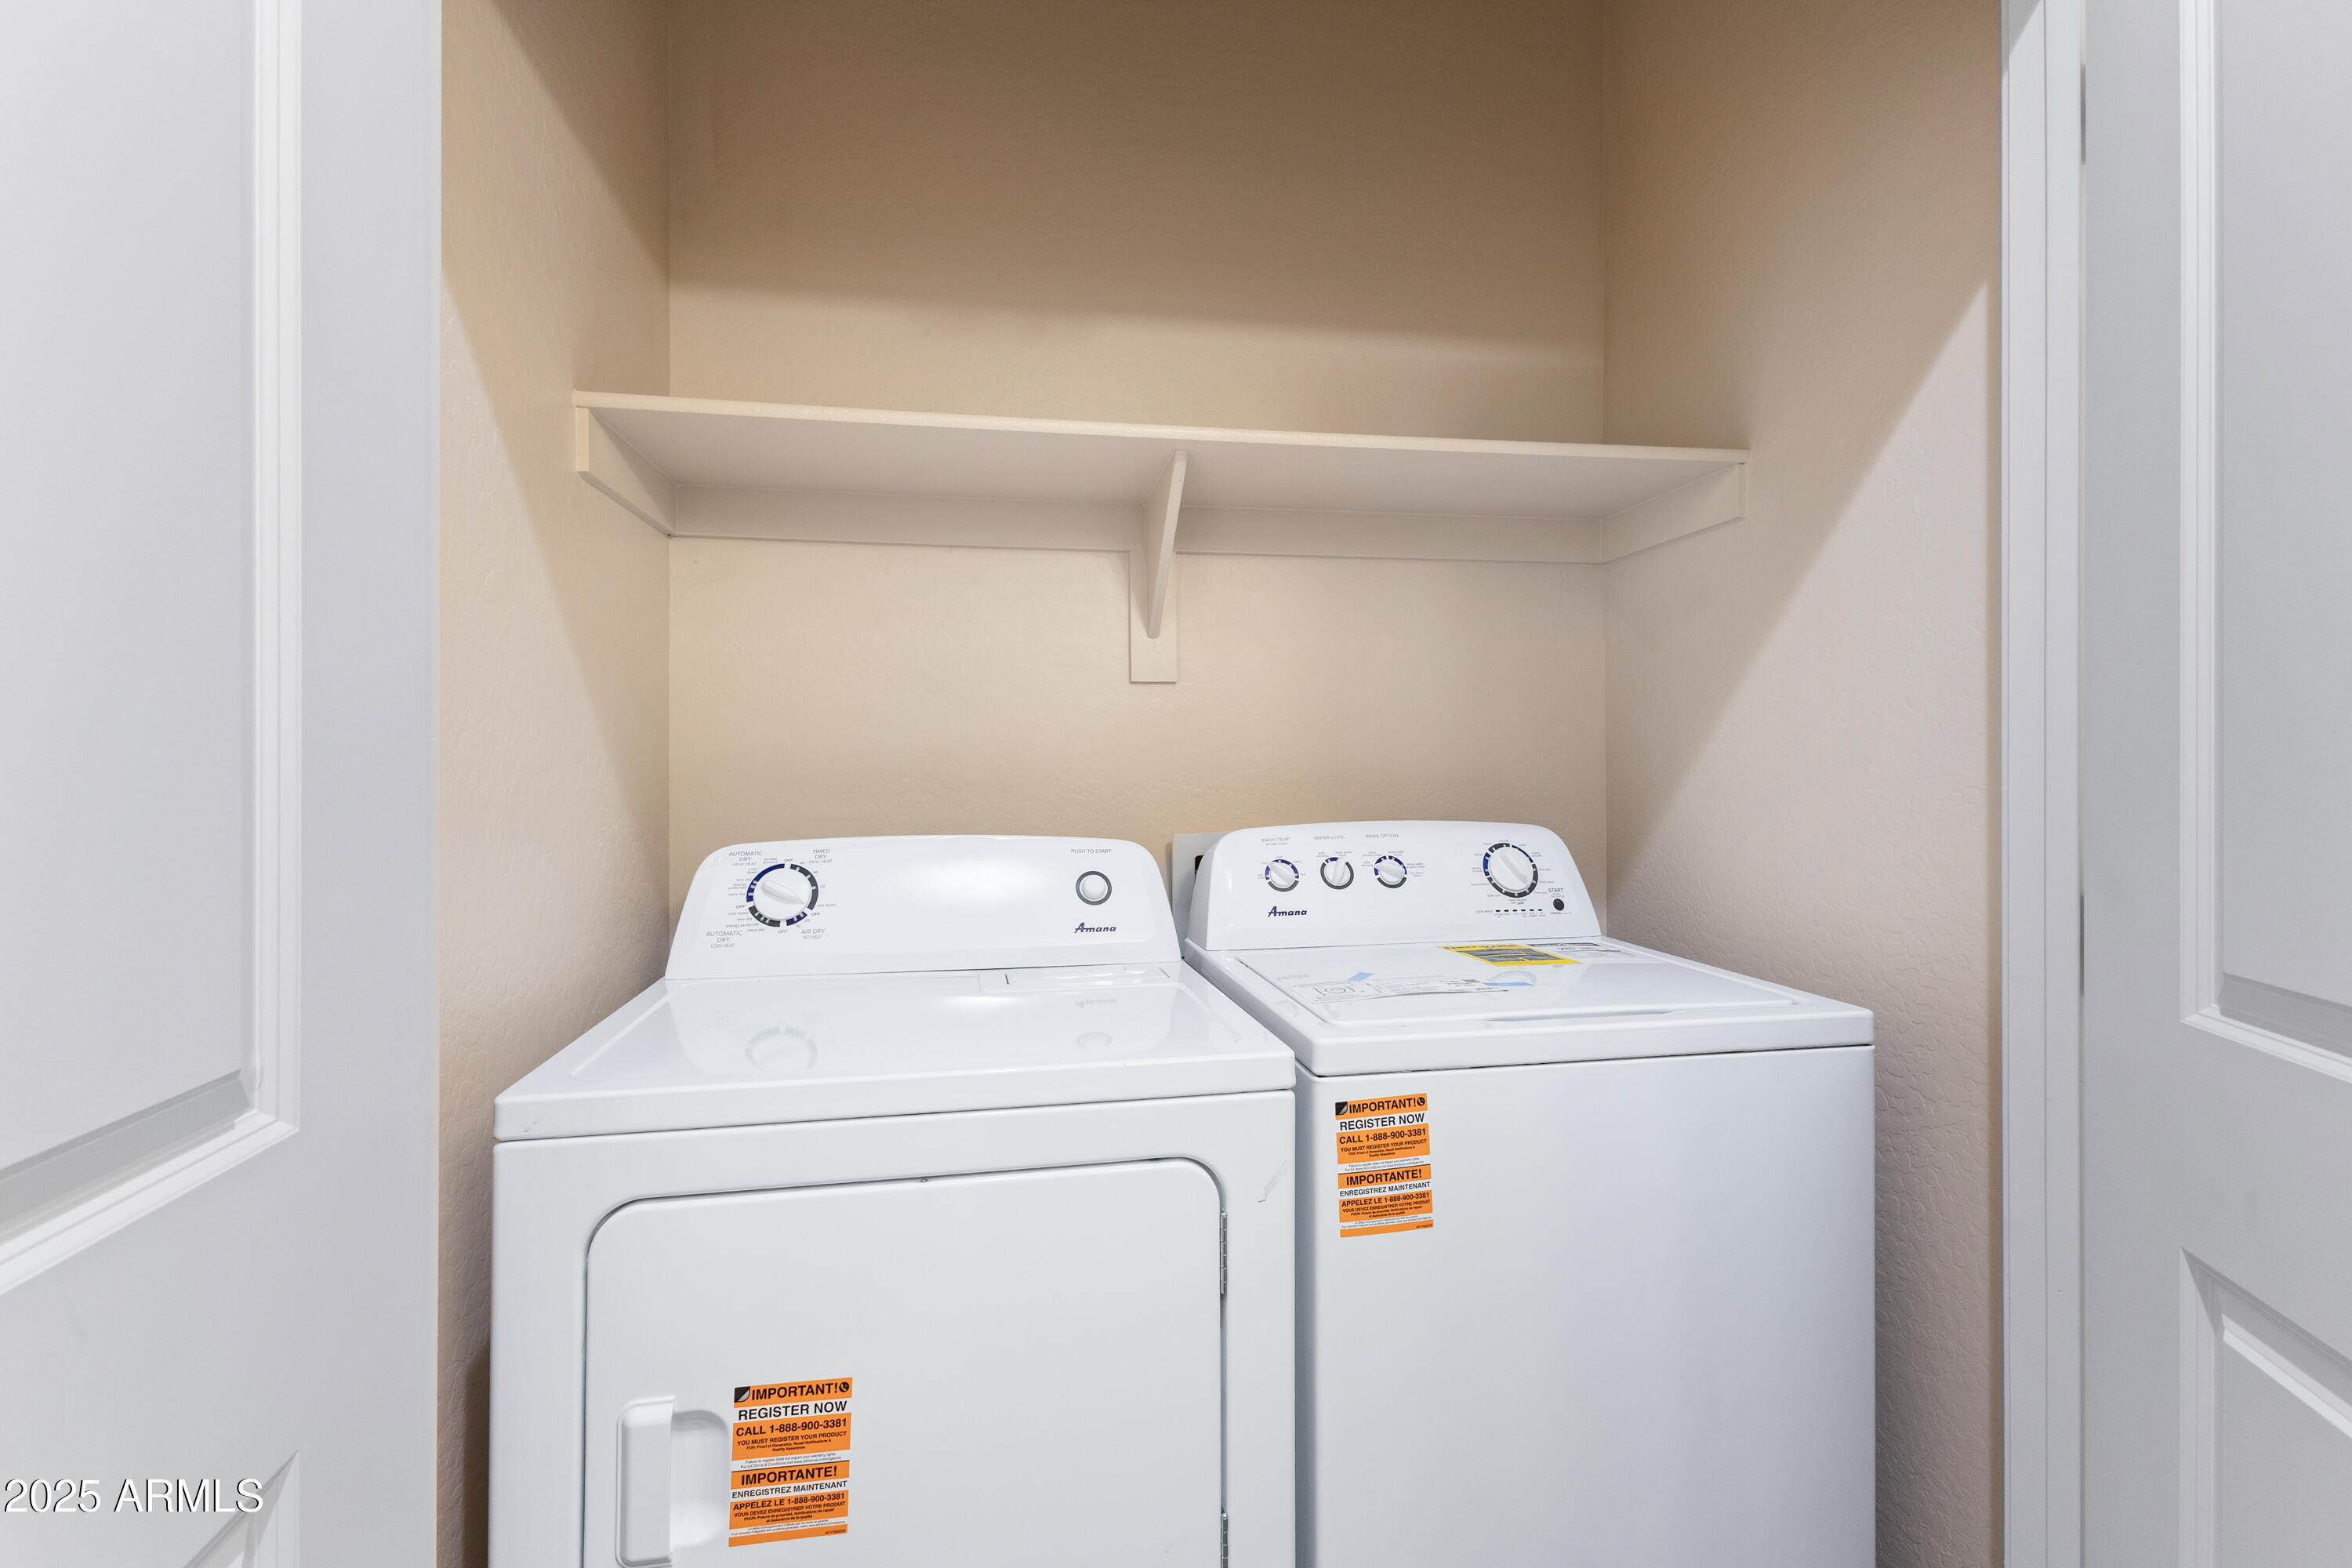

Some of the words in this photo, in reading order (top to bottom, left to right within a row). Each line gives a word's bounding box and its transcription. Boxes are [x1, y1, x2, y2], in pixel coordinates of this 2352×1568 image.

[1268, 906, 1307, 917] Amana
[1075, 923, 1116, 933] Amana
[1349, 1098, 1416, 1113] IMPORTANT!
[1340, 1116, 1396, 1131] REGISTER
[1399, 1113, 1425, 1123] NOW
[1340, 1135, 1363, 1144] CALL
[1366, 1128, 1426, 1142] 1-888-900-3381
[1346, 1169, 1421, 1185] IMPORTANTE!
[1340, 1187, 1387, 1196] ENREGISTREZ
[1388, 1181, 1430, 1192] MAINTENANT
[1385, 1192, 1429, 1203] 1-888-900-3381
[752, 1383, 837, 1400] IMPORTANT!
[739, 1404, 809, 1421] REGISTER
[814, 1401, 847, 1414] NOW
[736, 1425, 766, 1436] CALL
[770, 1418, 846, 1433] 1-888-900-3381
[742, 1466, 837, 1485] IMPORTANTE!
[732, 1487, 791, 1498] ENREGISTREZ
[793, 1481, 847, 1492] MAINTENANT
[734, 1501, 771, 1510] APPELEZ
[787, 1493, 844, 1504] 1-888-900-3381
